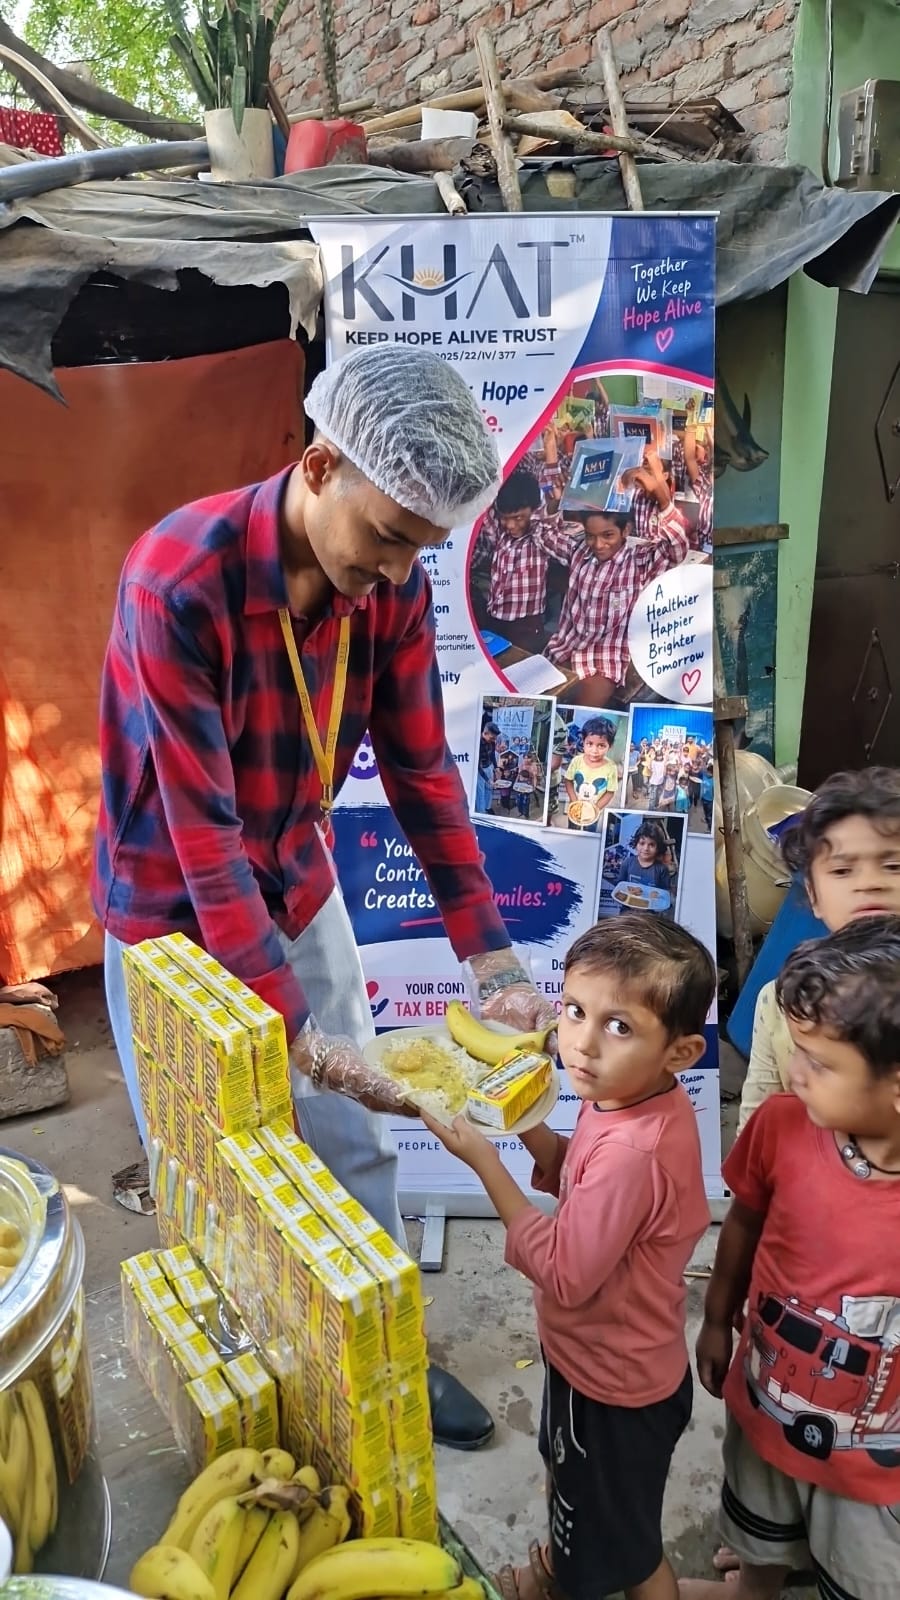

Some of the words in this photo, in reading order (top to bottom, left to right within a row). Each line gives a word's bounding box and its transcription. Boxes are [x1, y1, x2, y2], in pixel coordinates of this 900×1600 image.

[341, 242, 570, 322] KHAT
[630, 256, 688, 284] Together
[636, 285, 657, 304] We
[661, 279, 692, 298] Keep
[623, 306, 661, 332] Hope
[664, 297, 703, 322] Alive
[345, 330, 389, 345] KEEP
[394, 331, 443, 345] HOPE
[447, 330, 499, 344] ALIVE
[502, 328, 557, 343] TRUST
[482, 381, 529, 405] Hope
[655, 583, 664, 601] A
[646, 594, 699, 623] Healthier
[436, 633, 468, 643] tationery
[651, 615, 694, 640] Happier
[649, 634, 696, 660] Brighter
[646, 650, 704, 678] Tomorrow
[364, 887, 436, 909] Creates
[405, 983, 434, 995] YOUR
[394, 1001, 421, 1017] TAX
[680, 1074, 705, 1084] Reason
[398, 1142, 440, 1151] PEOPLE
